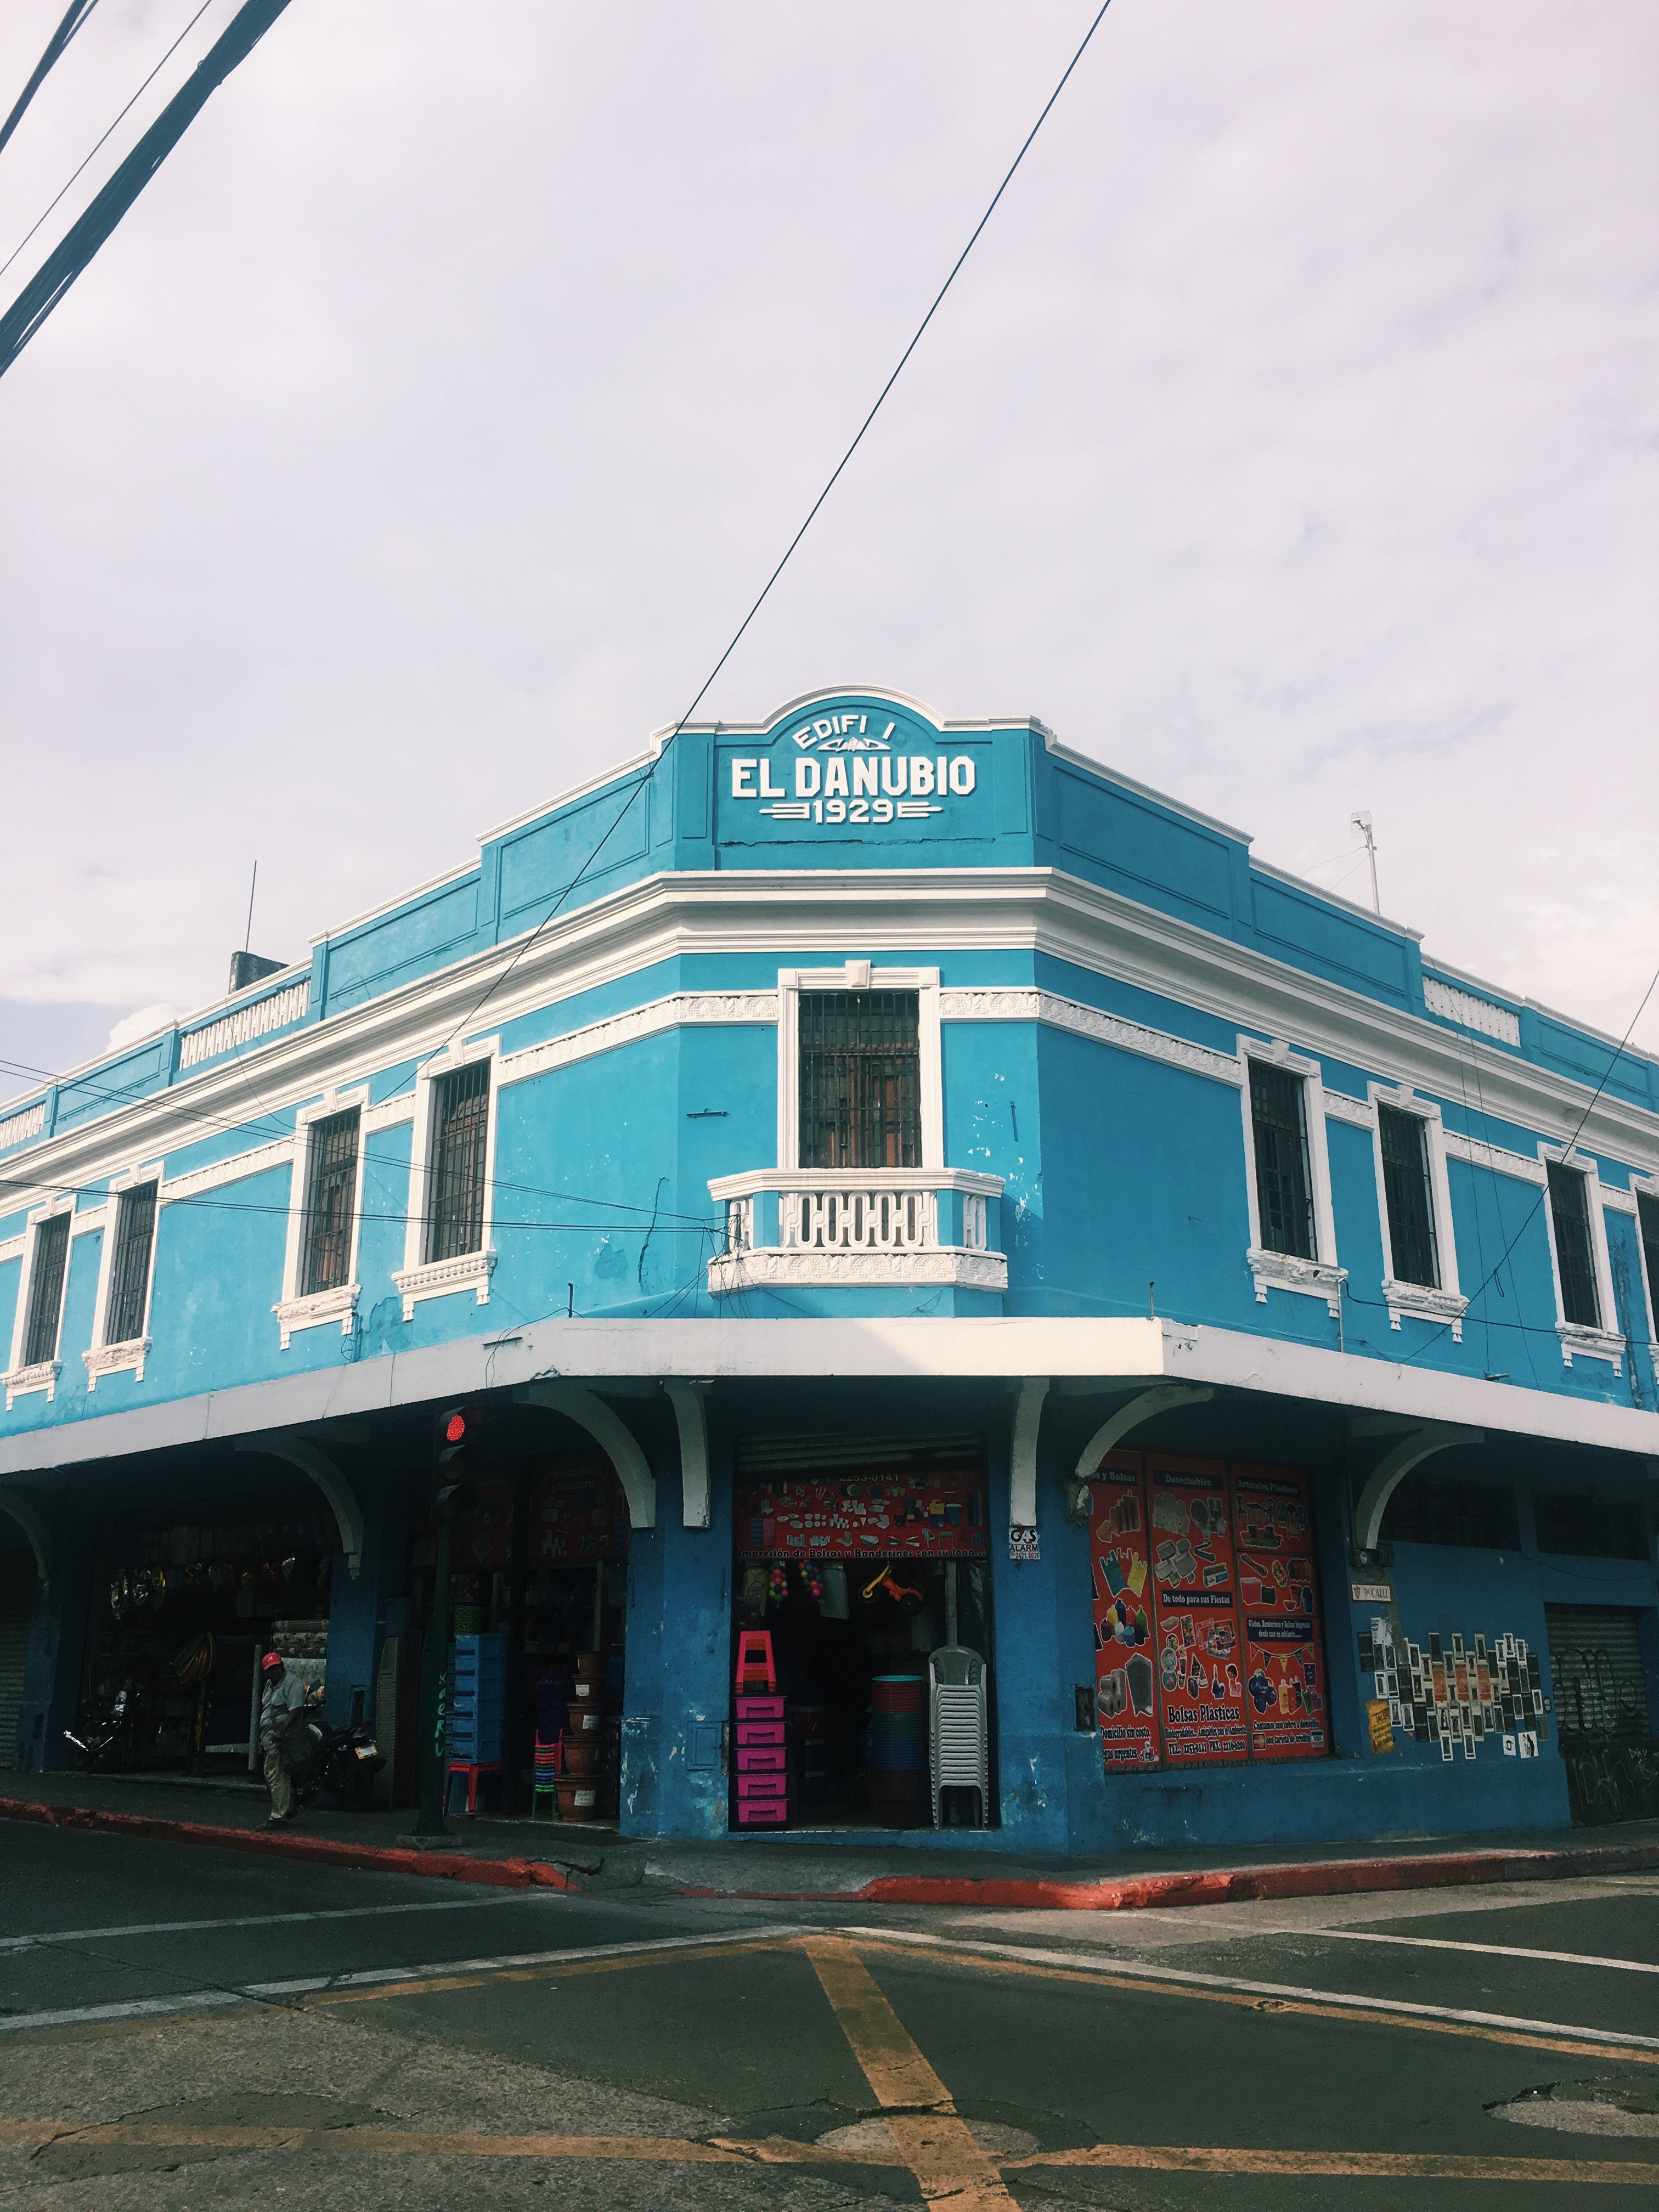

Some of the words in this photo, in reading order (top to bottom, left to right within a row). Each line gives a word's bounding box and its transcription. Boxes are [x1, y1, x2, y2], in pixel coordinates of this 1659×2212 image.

[732, 758, 785, 798] EL
[795, 755, 975, 798] DANUBIO
[814, 799, 893, 823] 1929
[1102, 1472, 1107, 1481] y
[1110, 1471, 1136, 1482] Bolsas
[1165, 1474, 1211, 1486] Desechables
[738, 1548, 789, 1558] Impresión
[793, 1548, 805, 1558] de
[809, 1548, 841, 1558] Bolsas
[854, 1548, 912, 1558] Banderines
[1163, 1594, 1171, 1602] De
[1172, 1594, 1185, 1603] todo
[1187, 1596, 1200, 1605] para
[1210, 1595, 1230, 1604] Fiestas
[1168, 1705, 1198, 1723] Bolsas
[1199, 1703, 1239, 1722] Plásticas
[1127, 1725, 1135, 1739] sin
